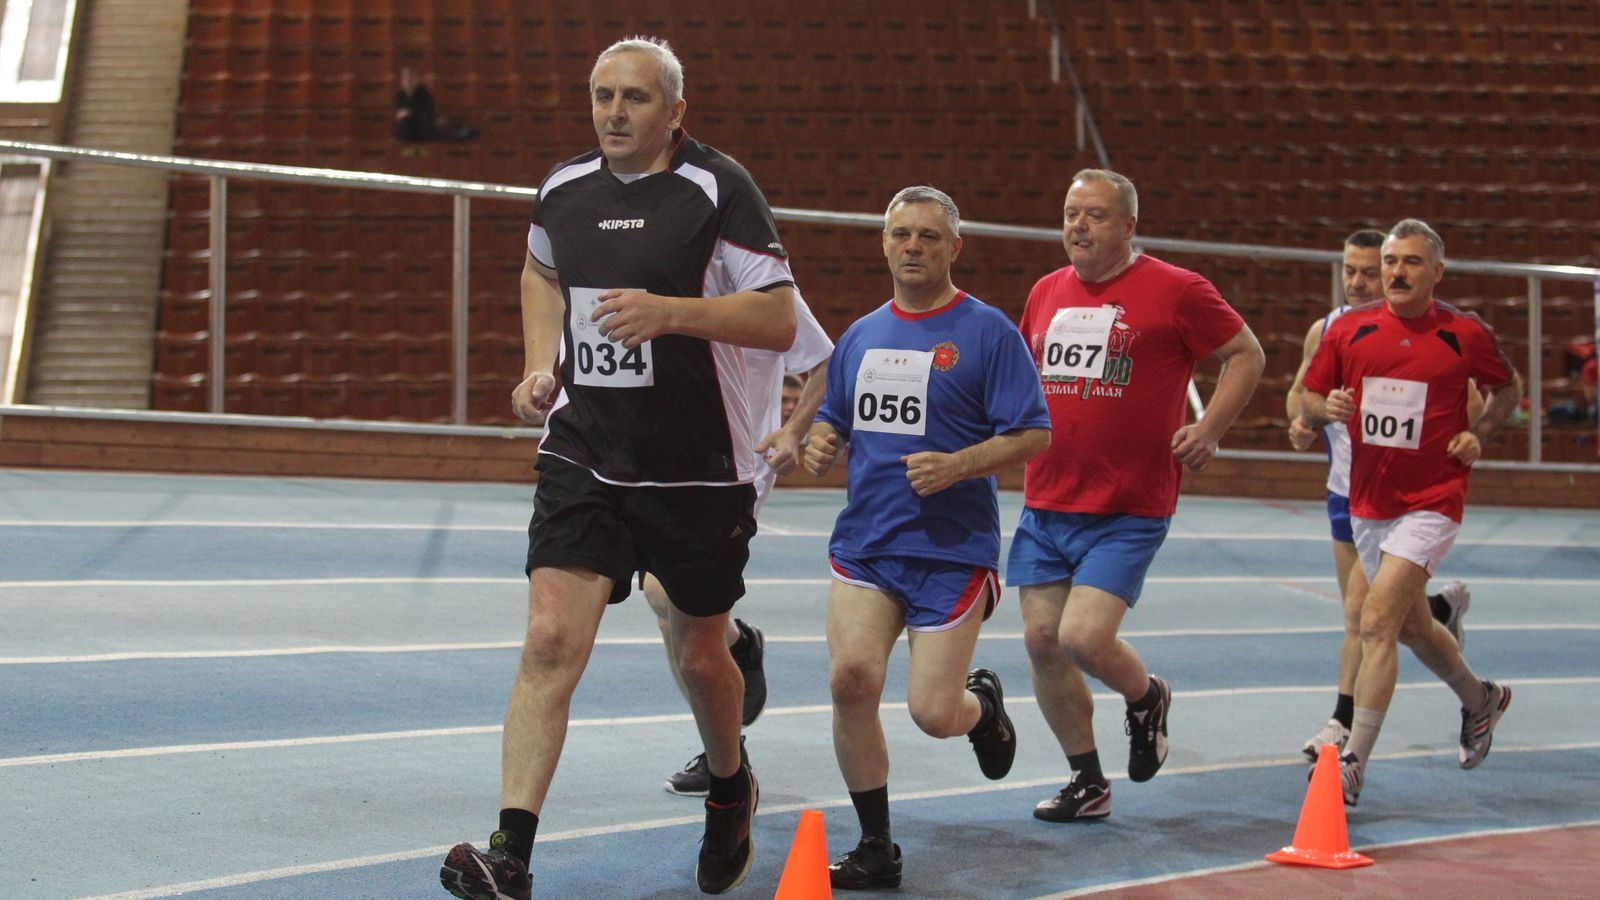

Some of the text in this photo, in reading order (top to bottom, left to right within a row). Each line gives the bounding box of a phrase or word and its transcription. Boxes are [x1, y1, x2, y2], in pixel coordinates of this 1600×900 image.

[577, 341, 647, 376] 034
[1047, 343, 1103, 368] 067
[1092, 386, 1123, 397] МАЯ
[858, 392, 922, 425] 056
[1365, 414, 1415, 441] 001
